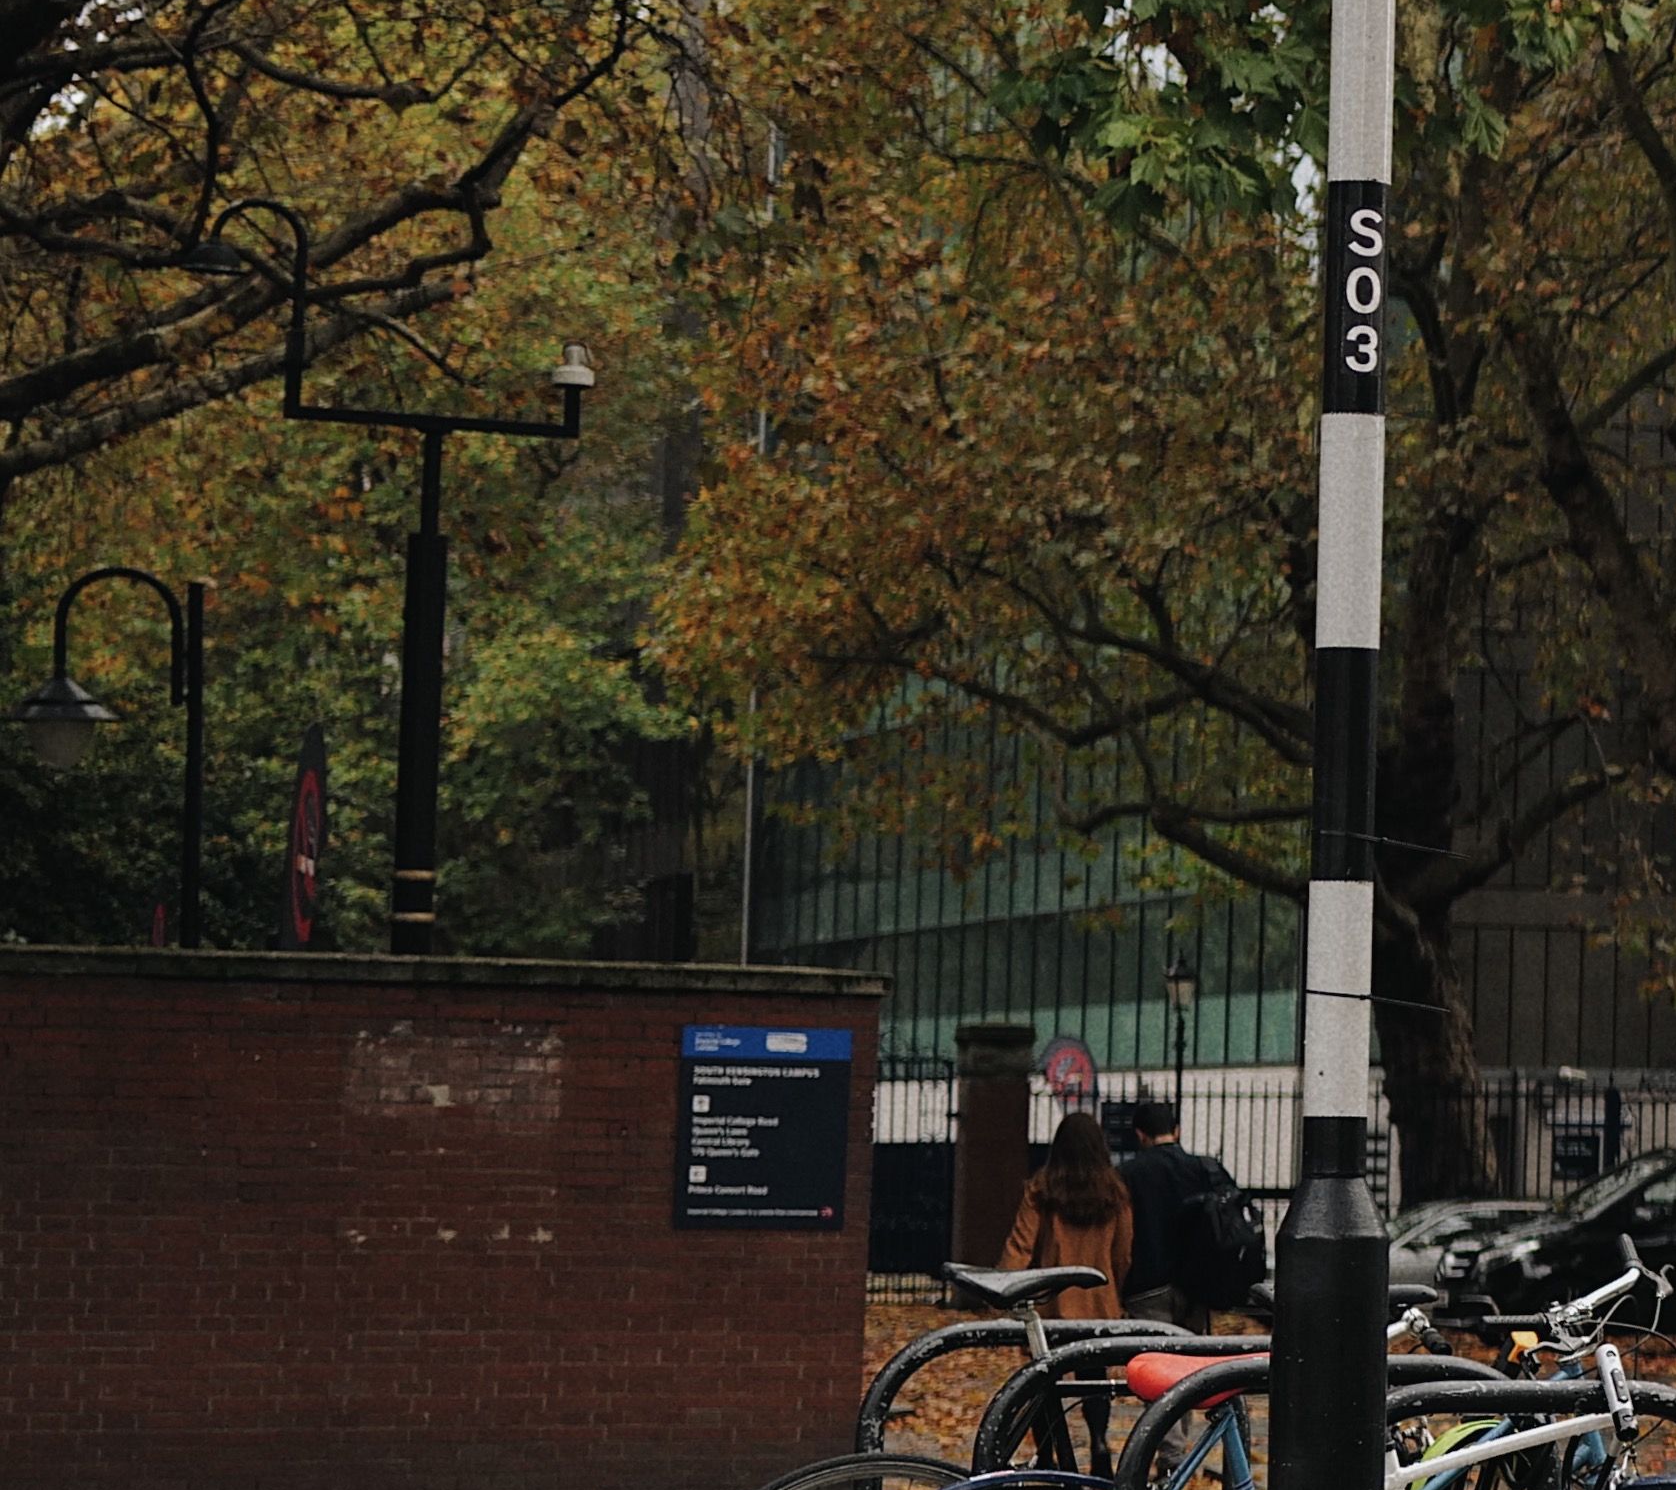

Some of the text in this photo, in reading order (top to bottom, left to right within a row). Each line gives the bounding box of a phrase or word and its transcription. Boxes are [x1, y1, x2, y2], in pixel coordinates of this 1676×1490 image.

[783, 1067, 821, 1078] CAMPUS
[757, 1116, 779, 1127] Road
[747, 1185, 769, 1196] Road
